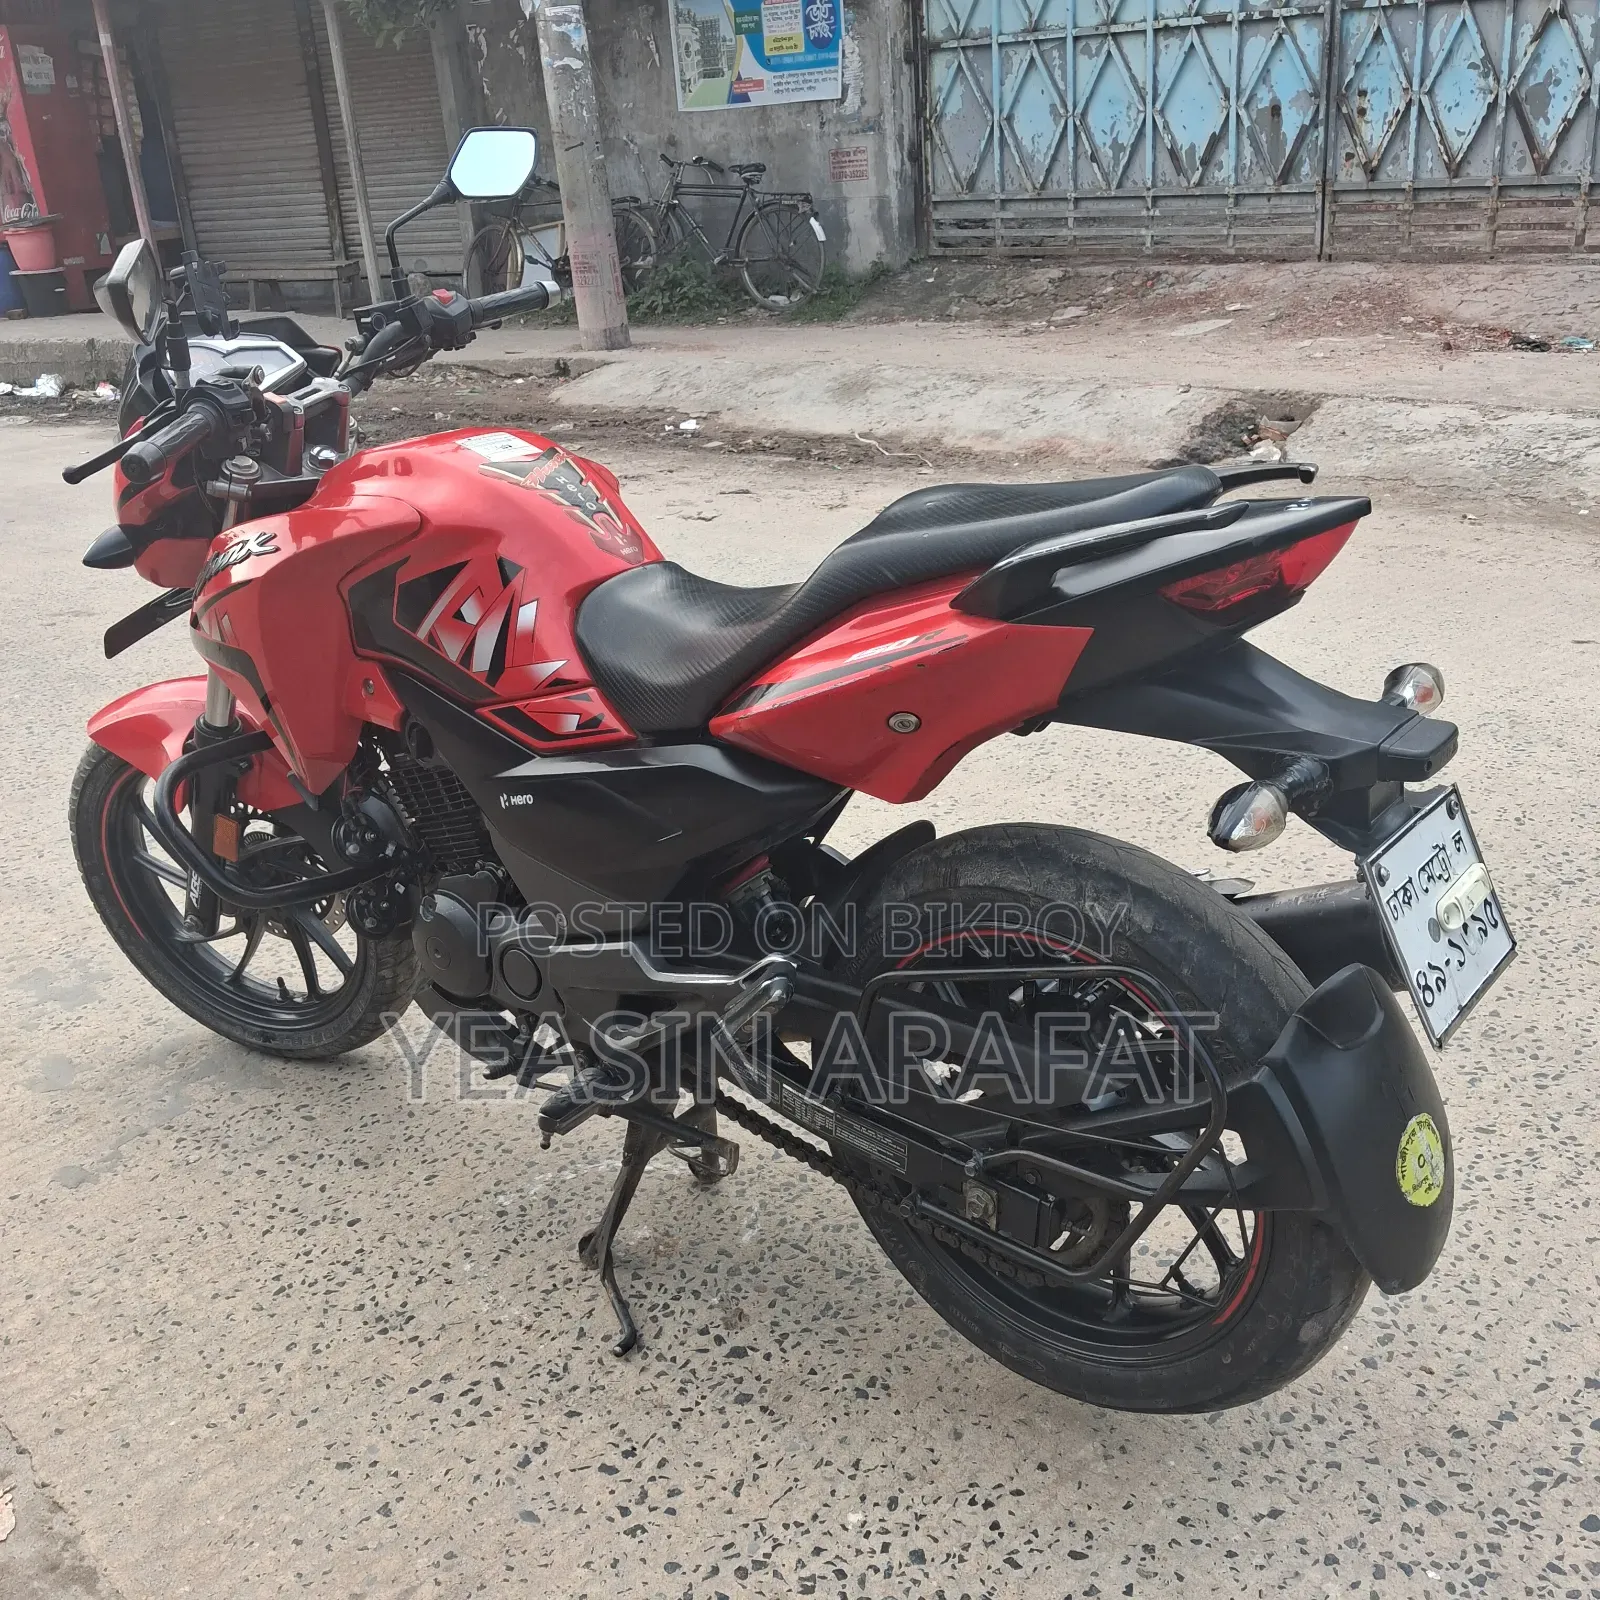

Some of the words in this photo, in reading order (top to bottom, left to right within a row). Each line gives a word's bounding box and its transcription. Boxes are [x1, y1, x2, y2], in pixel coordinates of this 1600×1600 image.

[620, 545, 639, 556] Hero
[510, 793, 534, 806] Hero
[1386, 876, 1419, 921] ঢাকা
[1418, 844, 1453, 893] মেট্রো
[1451, 830, 1468, 854] ল
